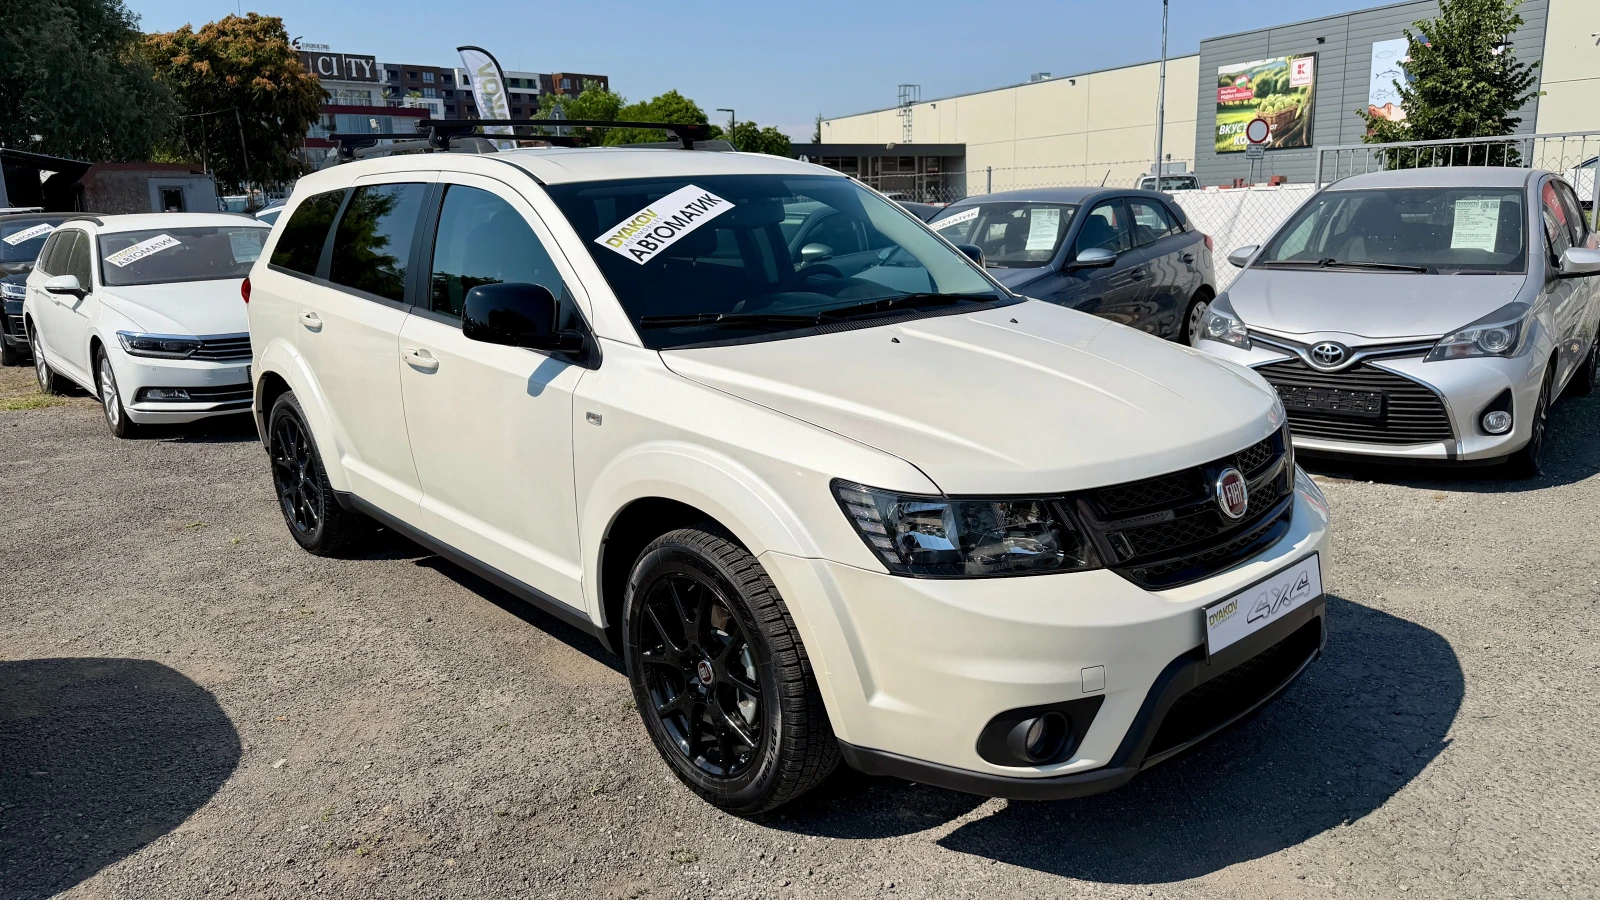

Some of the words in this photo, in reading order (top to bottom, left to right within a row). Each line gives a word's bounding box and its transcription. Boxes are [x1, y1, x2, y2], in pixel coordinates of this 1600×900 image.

[317, 55, 374, 78] CITY
[605, 208, 658, 249] DYAKOV
[628, 193, 722, 262] АВТОМАТИК
[117, 238, 174, 266] АВТОМАТИК
[1225, 481, 1243, 507] FIAT
[1208, 599, 1238, 627] DYAKOV
